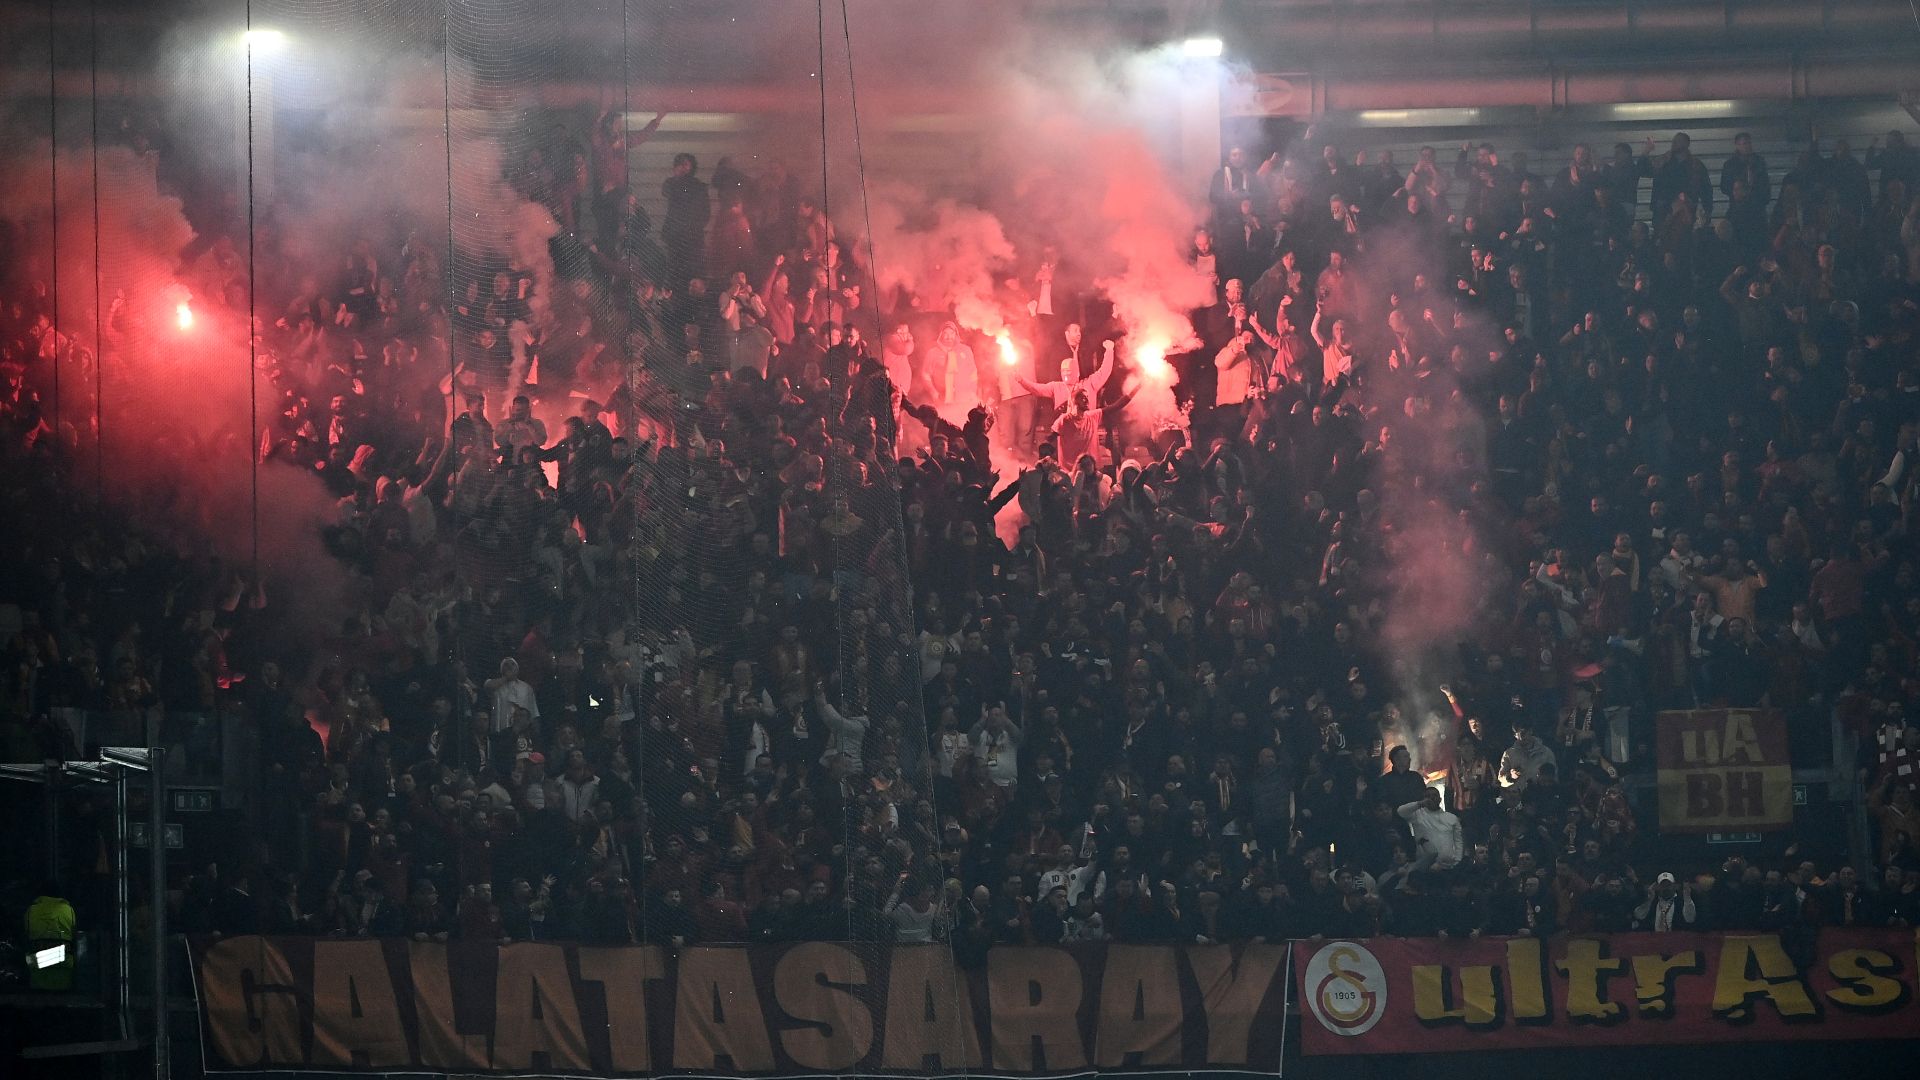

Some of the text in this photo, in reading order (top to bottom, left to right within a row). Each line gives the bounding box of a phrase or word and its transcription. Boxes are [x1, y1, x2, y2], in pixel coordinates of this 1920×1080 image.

[1685, 771, 1766, 818] BH
[201, 934, 1284, 1071] GALATASARAY
[1334, 991, 1356, 1000] 1905
[1411, 934, 1920, 1025] ultrAs
